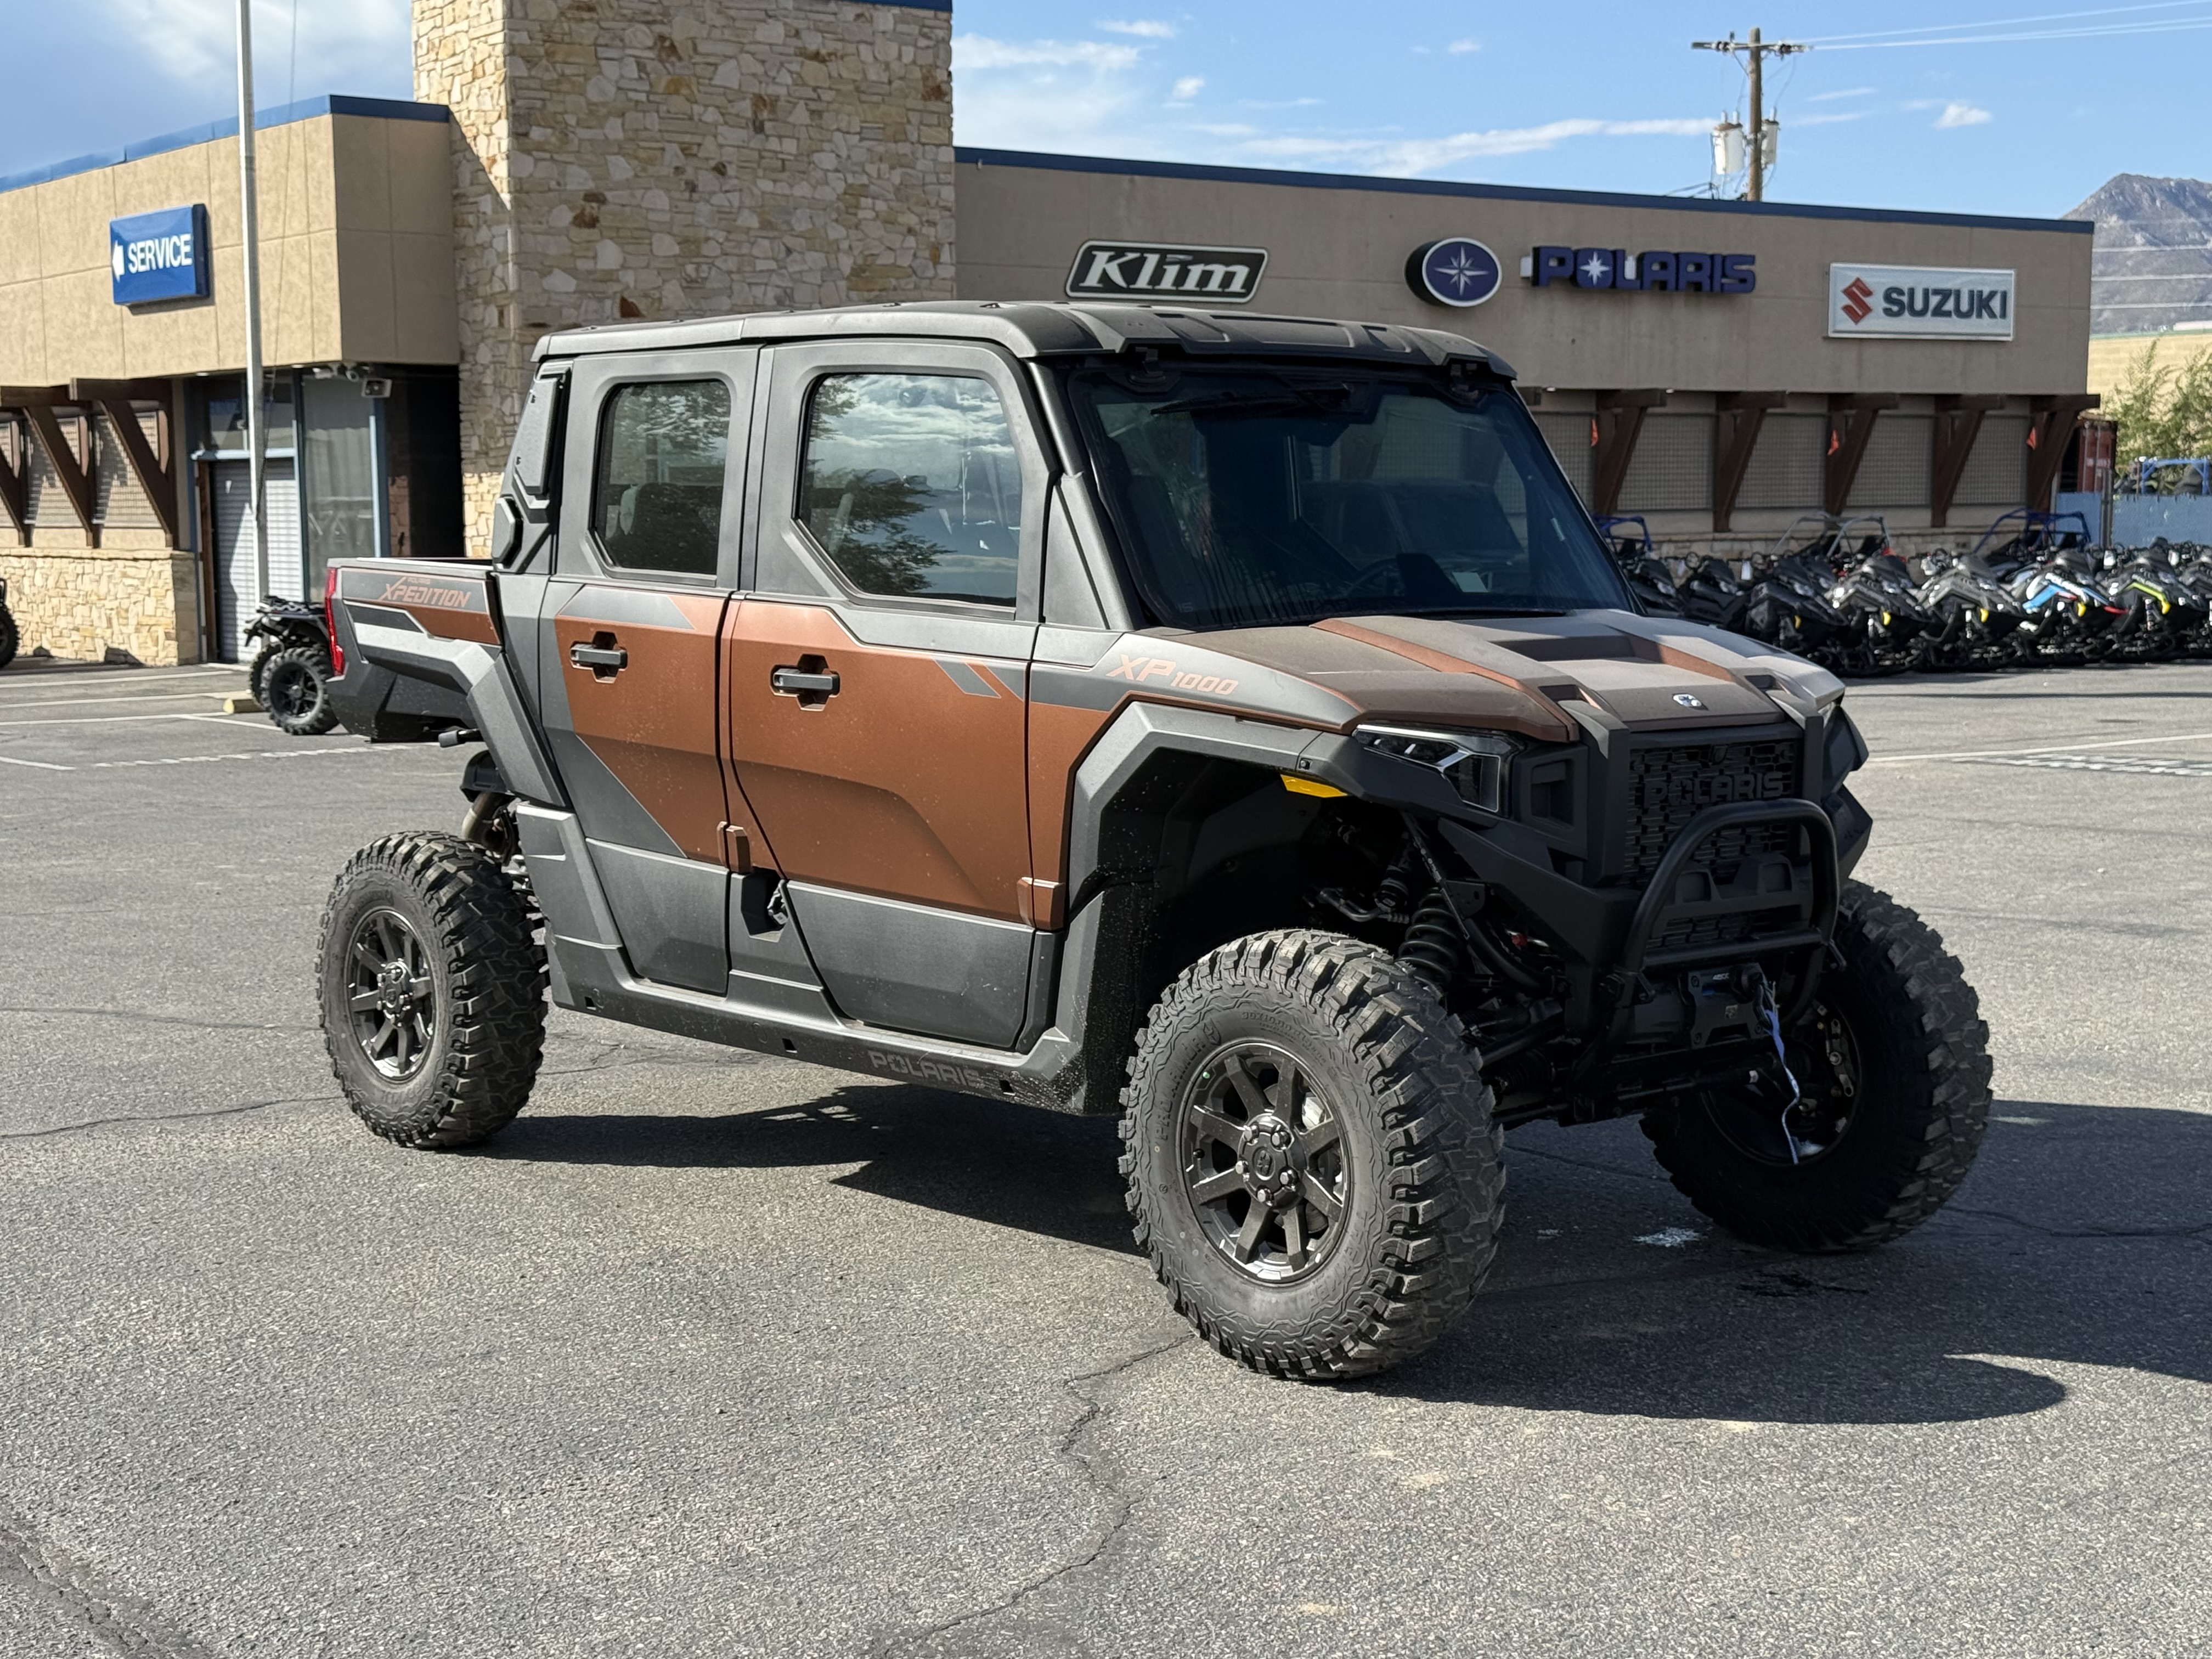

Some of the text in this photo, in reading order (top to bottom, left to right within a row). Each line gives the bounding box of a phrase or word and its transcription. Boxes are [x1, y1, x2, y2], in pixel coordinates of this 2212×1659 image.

[128, 233, 192, 274] SERVICE
[1079, 251, 1250, 292] Klim
[1534, 246, 1756, 293] POLARIS
[1883, 287, 2007, 319] SUZUKI
[378, 577, 471, 607] XPEDITION
[1105, 654, 1238, 696] XP 1000
[1644, 771, 1783, 808] POLARIS
[867, 1049, 981, 1088] POLARIS
